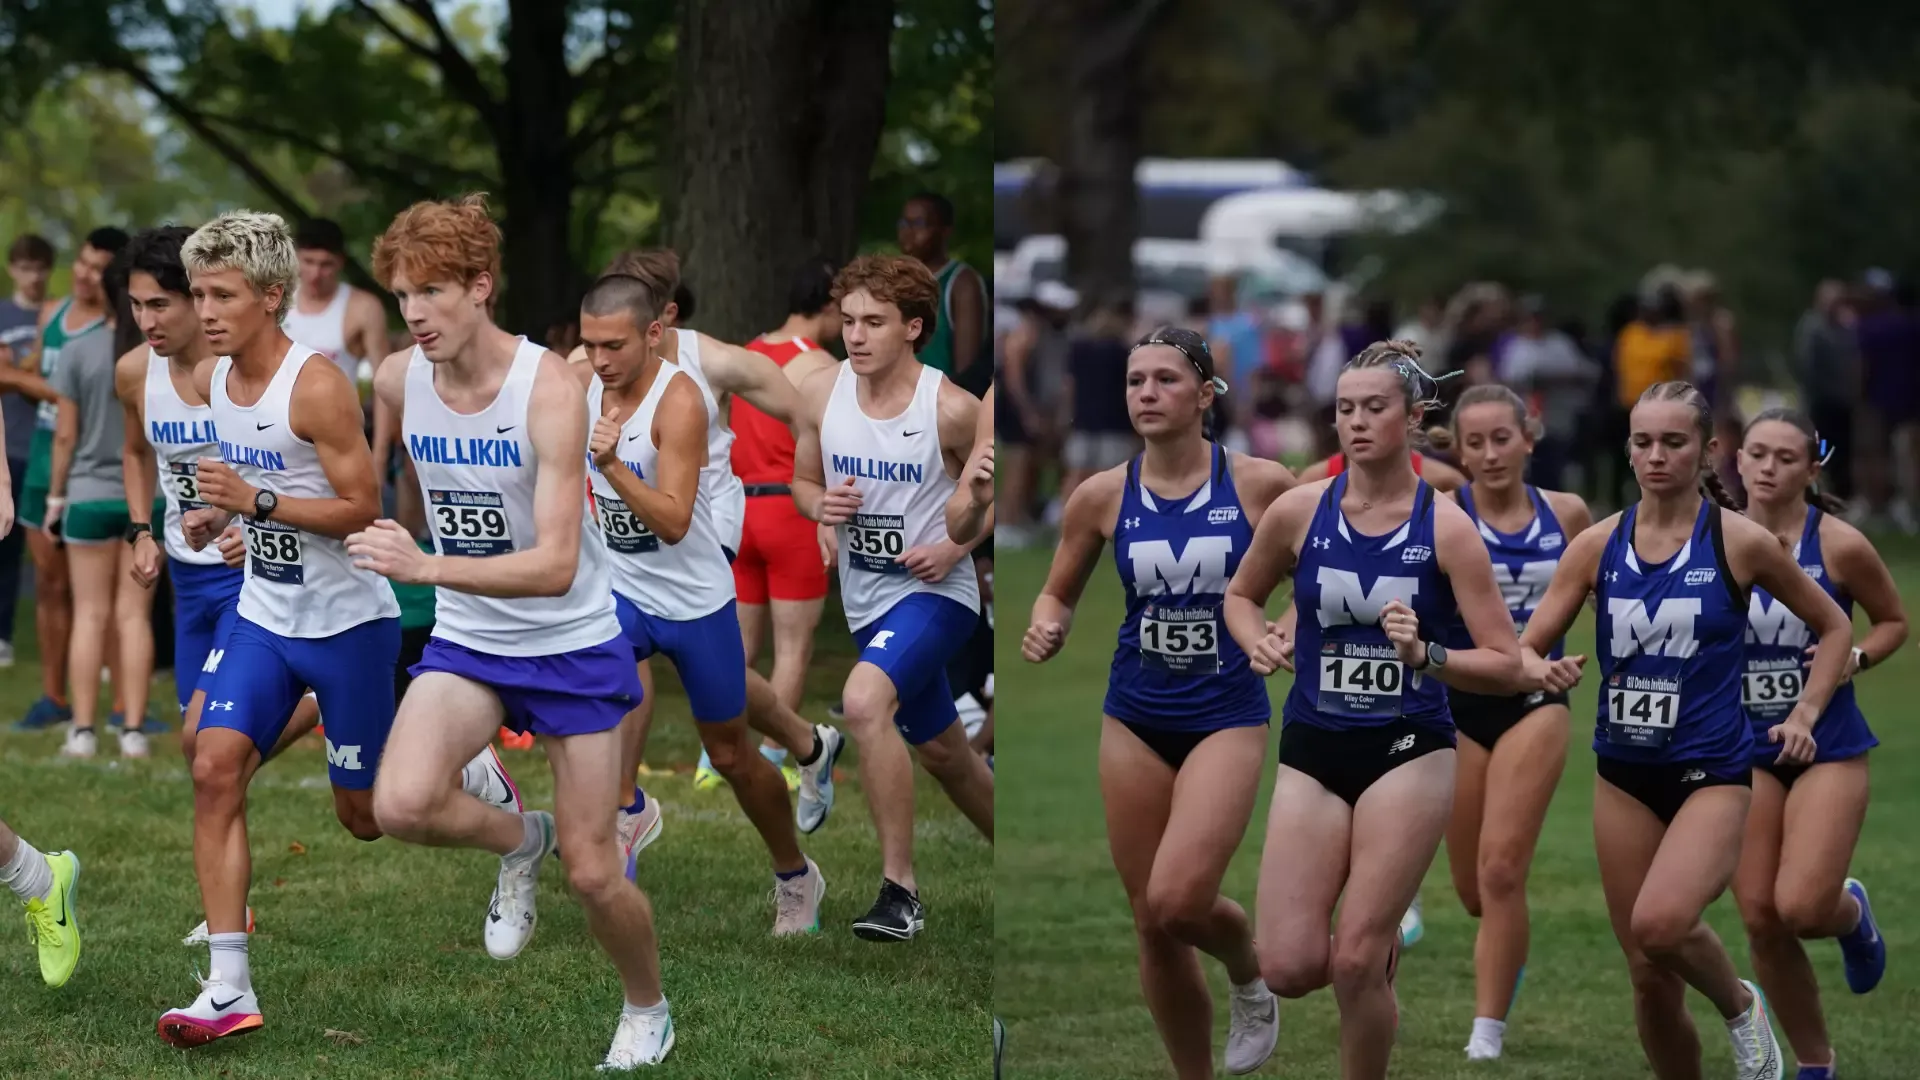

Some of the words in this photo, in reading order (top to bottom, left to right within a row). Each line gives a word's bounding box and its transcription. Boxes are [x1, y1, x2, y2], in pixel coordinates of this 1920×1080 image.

[151, 420, 218, 444] MILLI
[410, 434, 522, 467] MILLIKIN
[832, 454, 923, 483] MILLIKIN
[437, 507, 505, 537] 359
[601, 509, 650, 536] 366
[1207, 508, 1240, 523] CCIW
[248, 527, 299, 562] 358
[848, 527, 903, 555] 350
[1401, 547, 1432, 562] CCIW
[1128, 536, 1233, 597] M
[1684, 569, 1717, 584] CCIW
[1316, 566, 1419, 629] M
[1167, 608, 1184, 621] Dodds
[1185, 607, 1214, 620] Invitational
[1608, 597, 1702, 659] M
[1144, 622, 1215, 652] 153
[1344, 643, 1352, 656] Gil
[1352, 644, 1370, 657] Dodds
[1370, 645, 1398, 658] Invitation
[1326, 659, 1400, 693] 140
[1626, 676, 1634, 688] Gil
[1634, 677, 1650, 690] Dodds
[1651, 678, 1679, 692] Invitational
[1742, 672, 1800, 701] 139
[1359, 695, 1375, 703] Coker
[1612, 691, 1672, 725] 141
